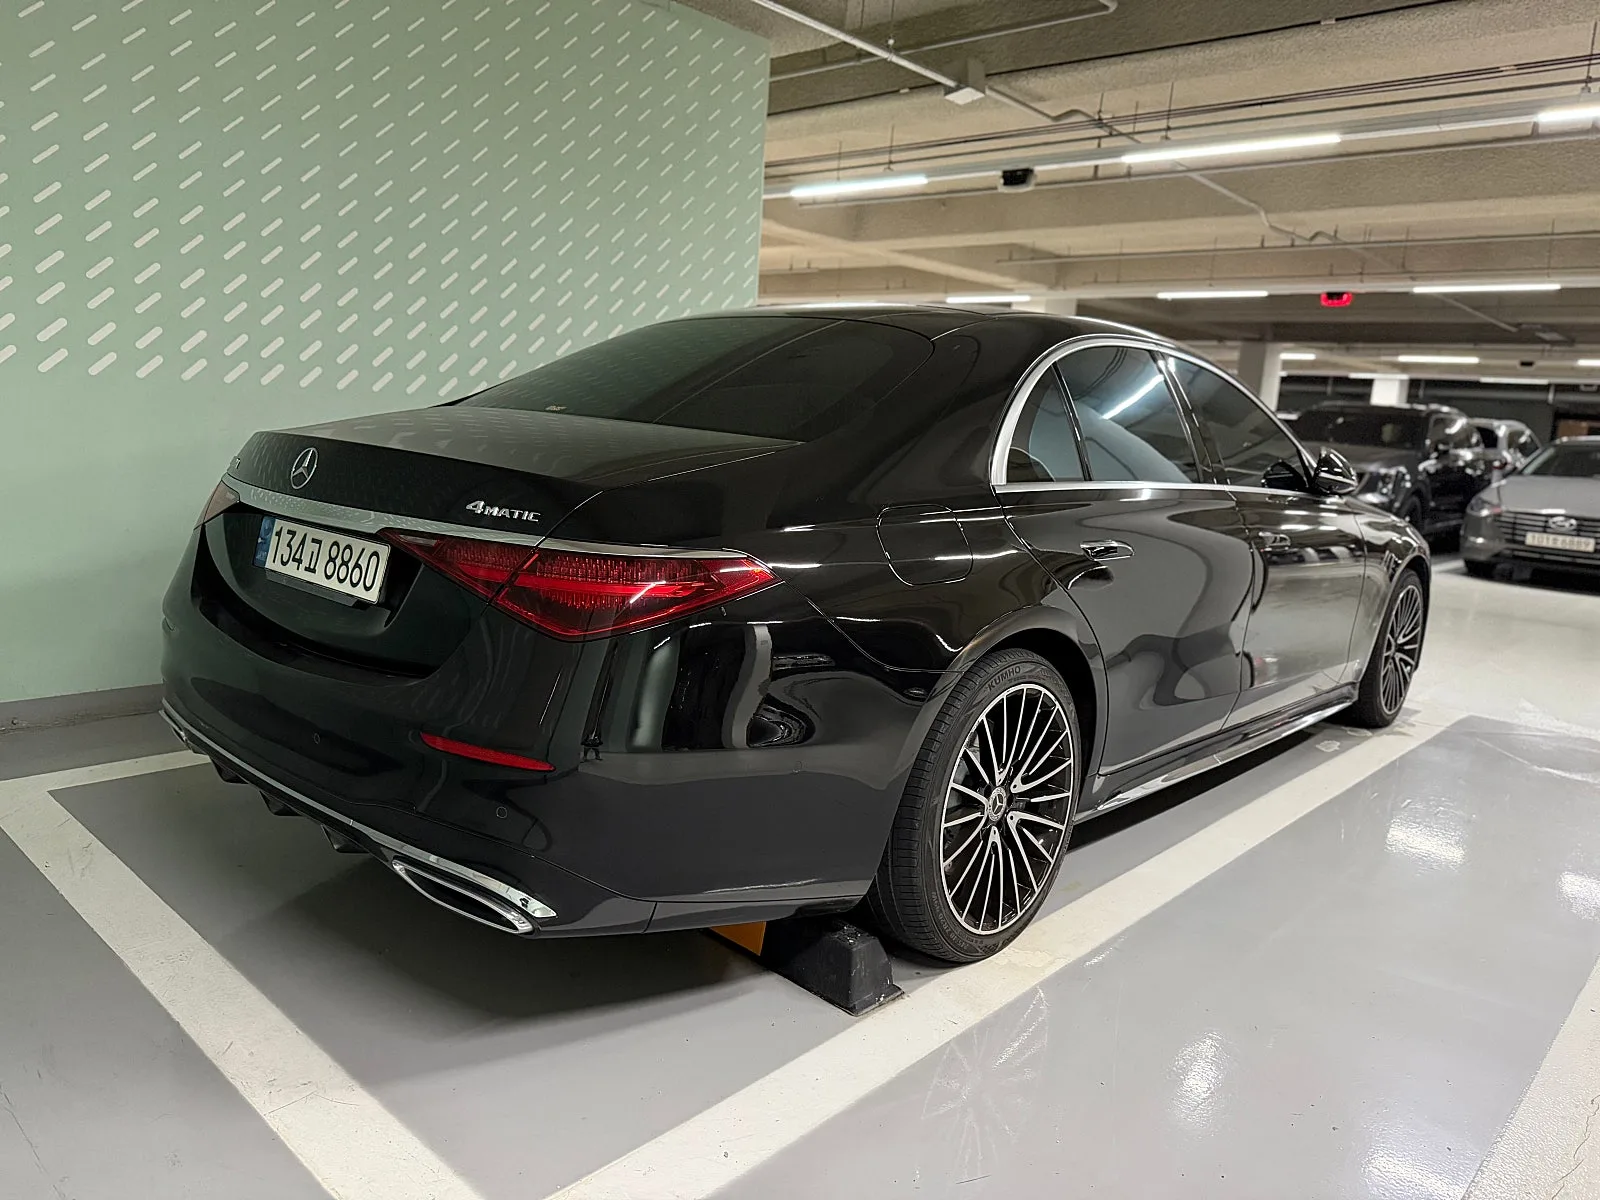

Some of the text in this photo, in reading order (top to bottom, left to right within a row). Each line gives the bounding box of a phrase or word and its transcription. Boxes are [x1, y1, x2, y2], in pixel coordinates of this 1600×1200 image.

[465, 500, 541, 523] 4MATIC
[324, 540, 381, 591] 8860
[987, 665, 1021, 691] KUMHO
